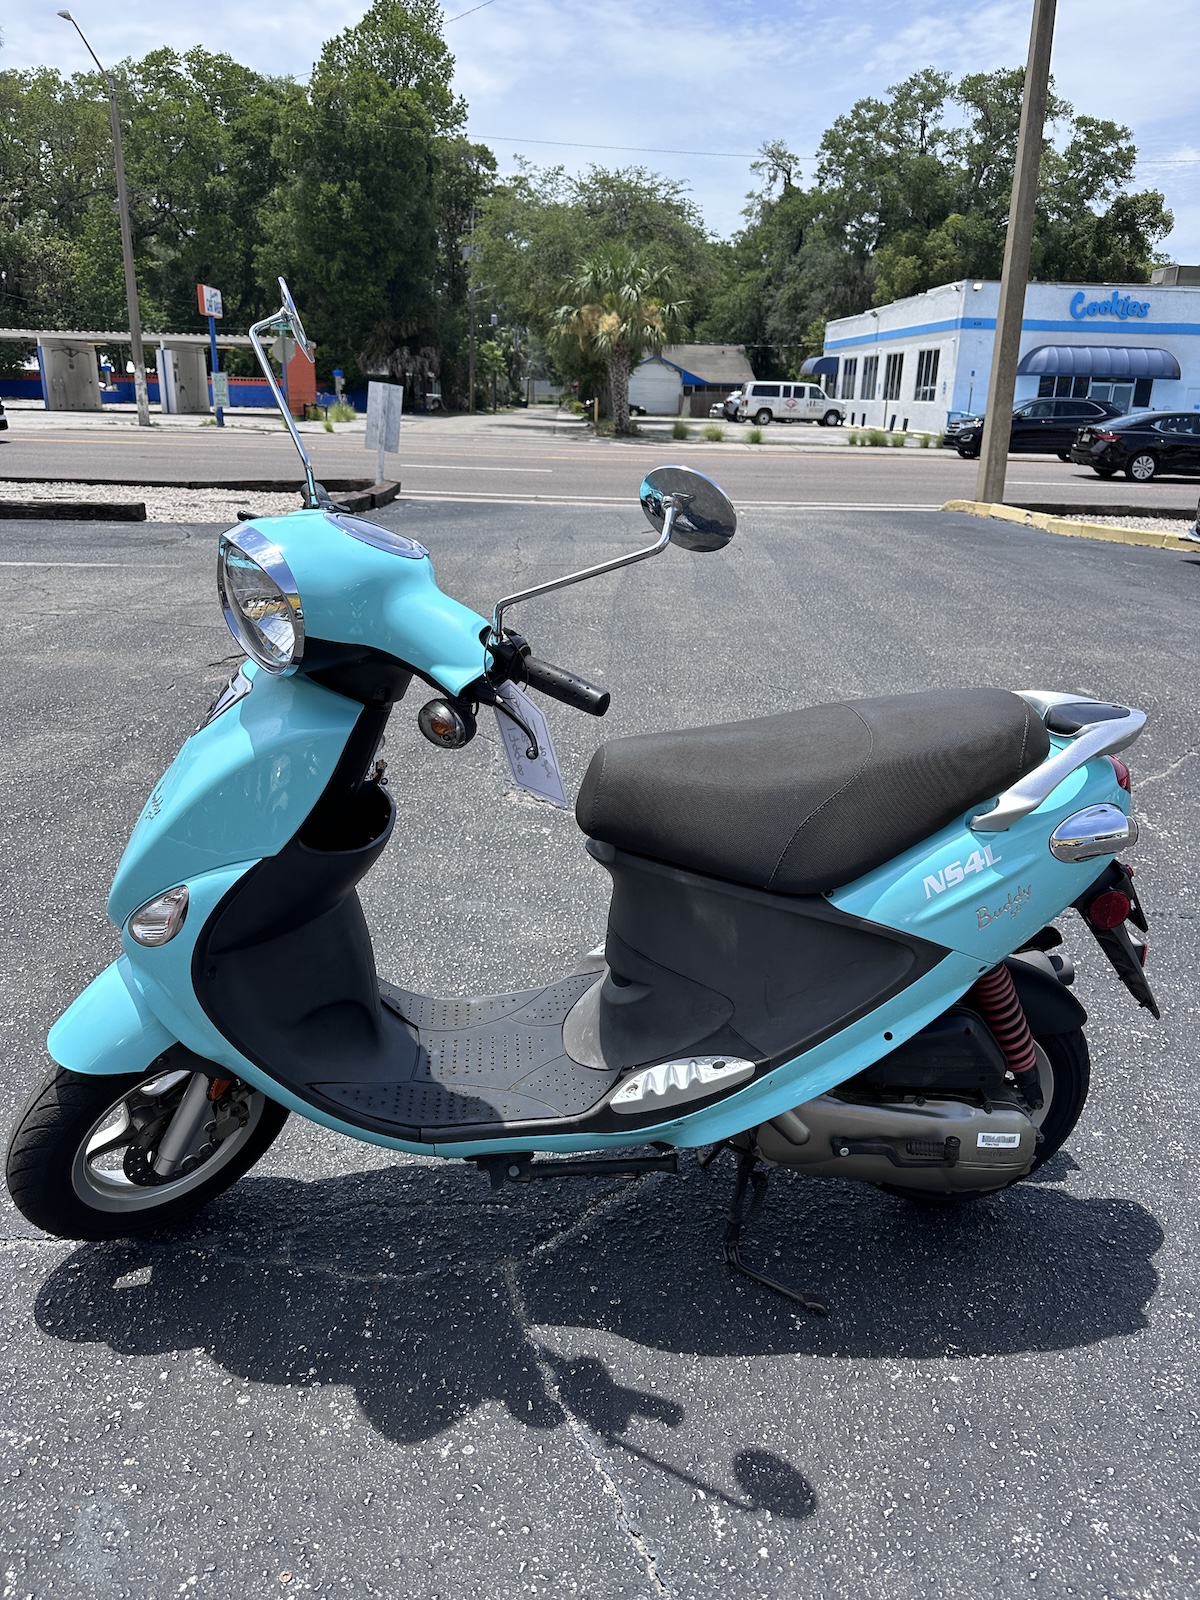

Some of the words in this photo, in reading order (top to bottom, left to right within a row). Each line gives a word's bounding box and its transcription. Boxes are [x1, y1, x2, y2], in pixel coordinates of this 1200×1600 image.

[1070, 291, 1151, 320] Cookies
[922, 844, 1002, 899] NS4L
[976, 884, 1032, 931] Buddy
